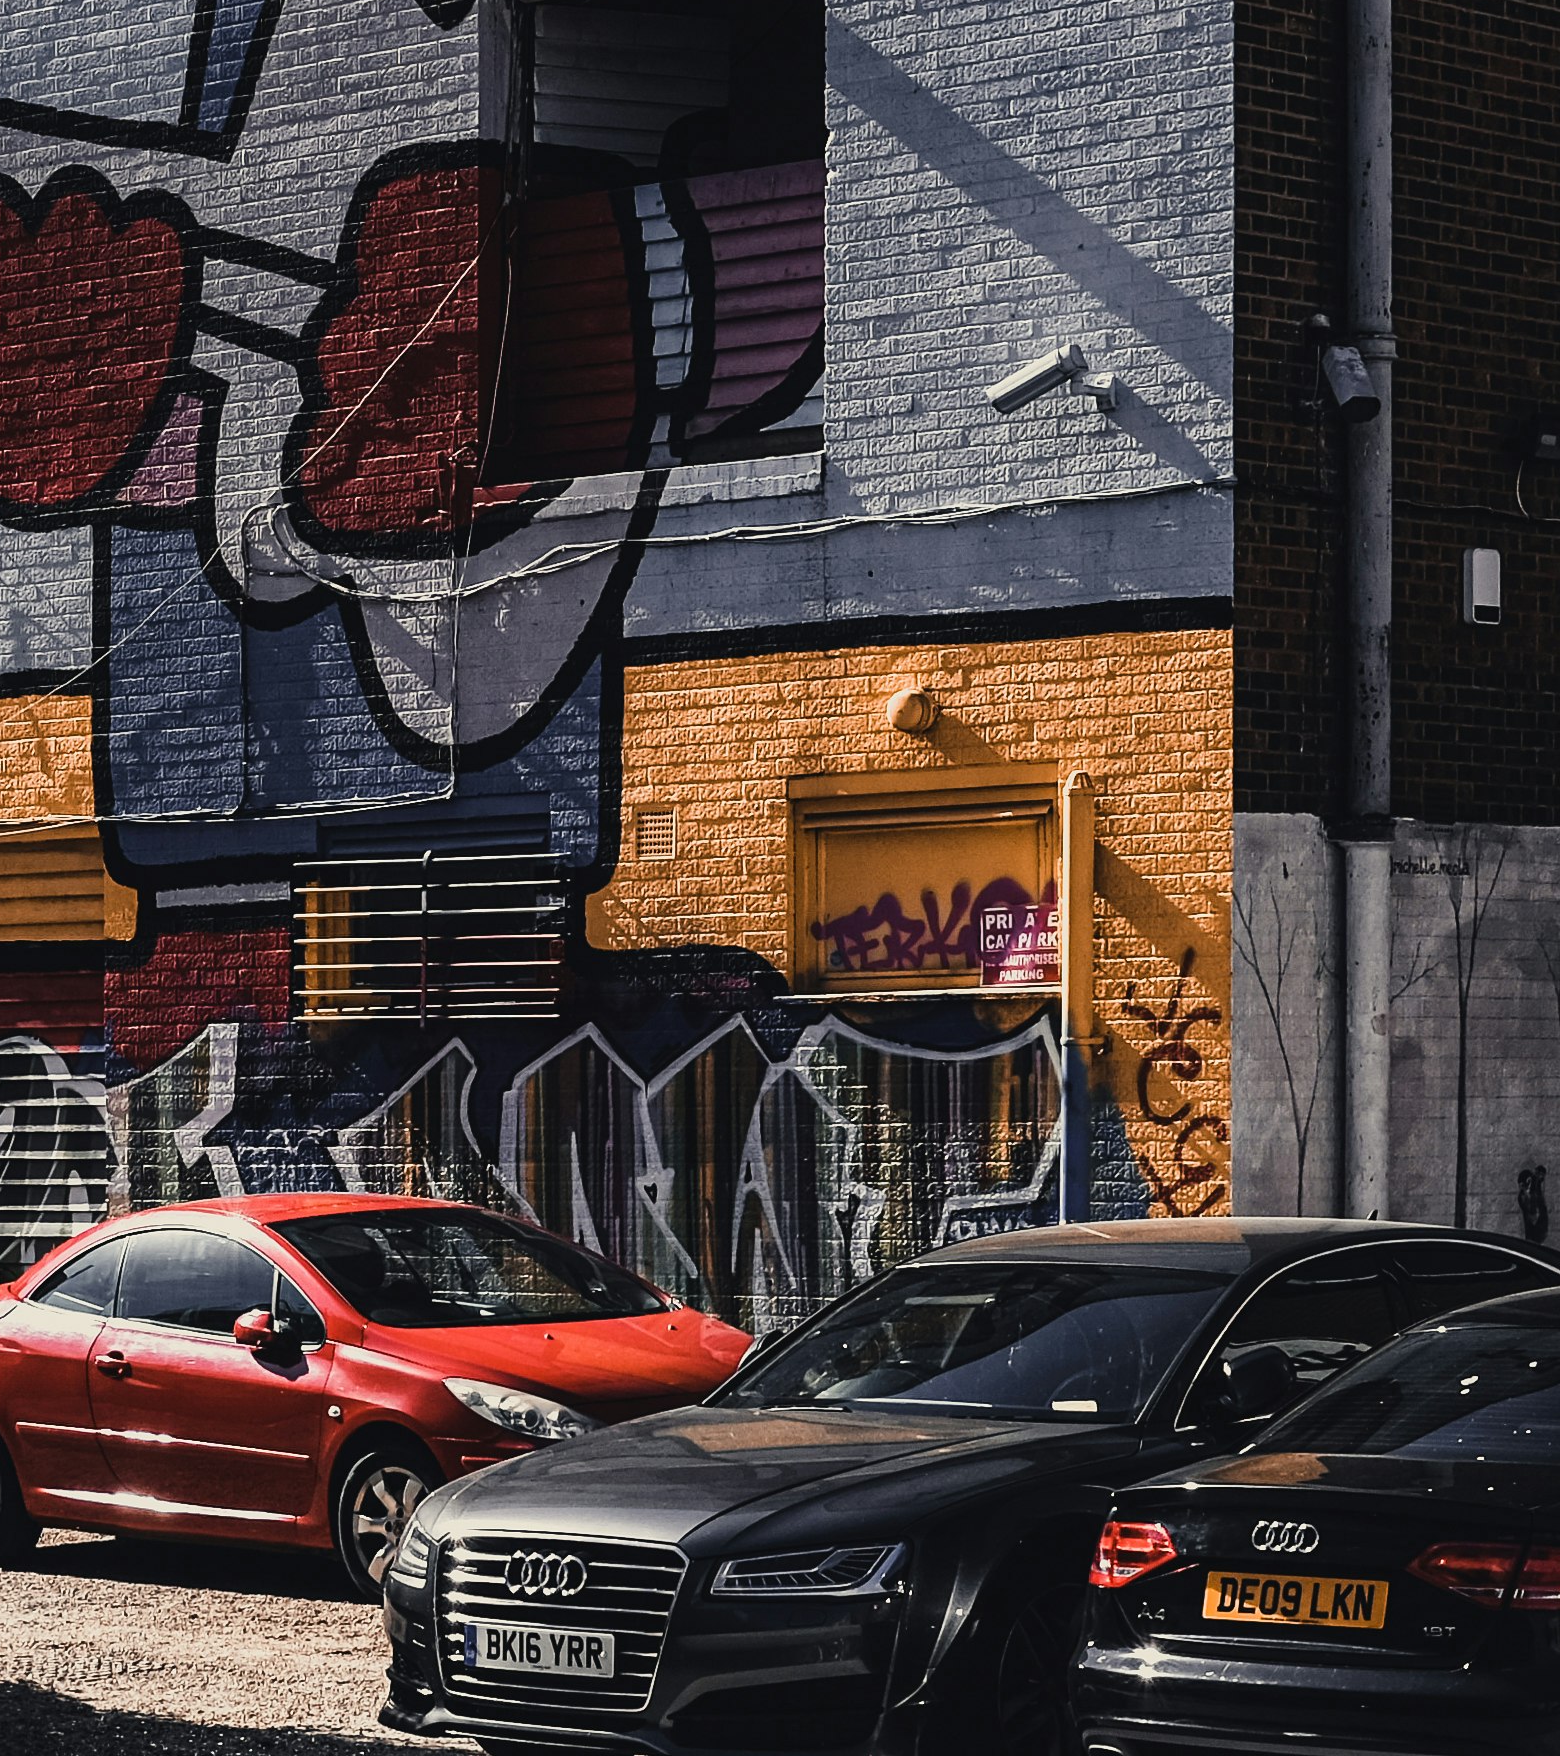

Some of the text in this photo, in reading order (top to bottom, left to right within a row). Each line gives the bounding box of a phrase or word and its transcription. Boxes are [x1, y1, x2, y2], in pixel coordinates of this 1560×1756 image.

[985, 911, 1059, 930] PRIAE
[999, 969, 1044, 981] PARKING
[1216, 1577, 1375, 1621] DE09 LKN
[1137, 1602, 1165, 1621] A4
[487, 1629, 603, 1669] BK16 YRR
